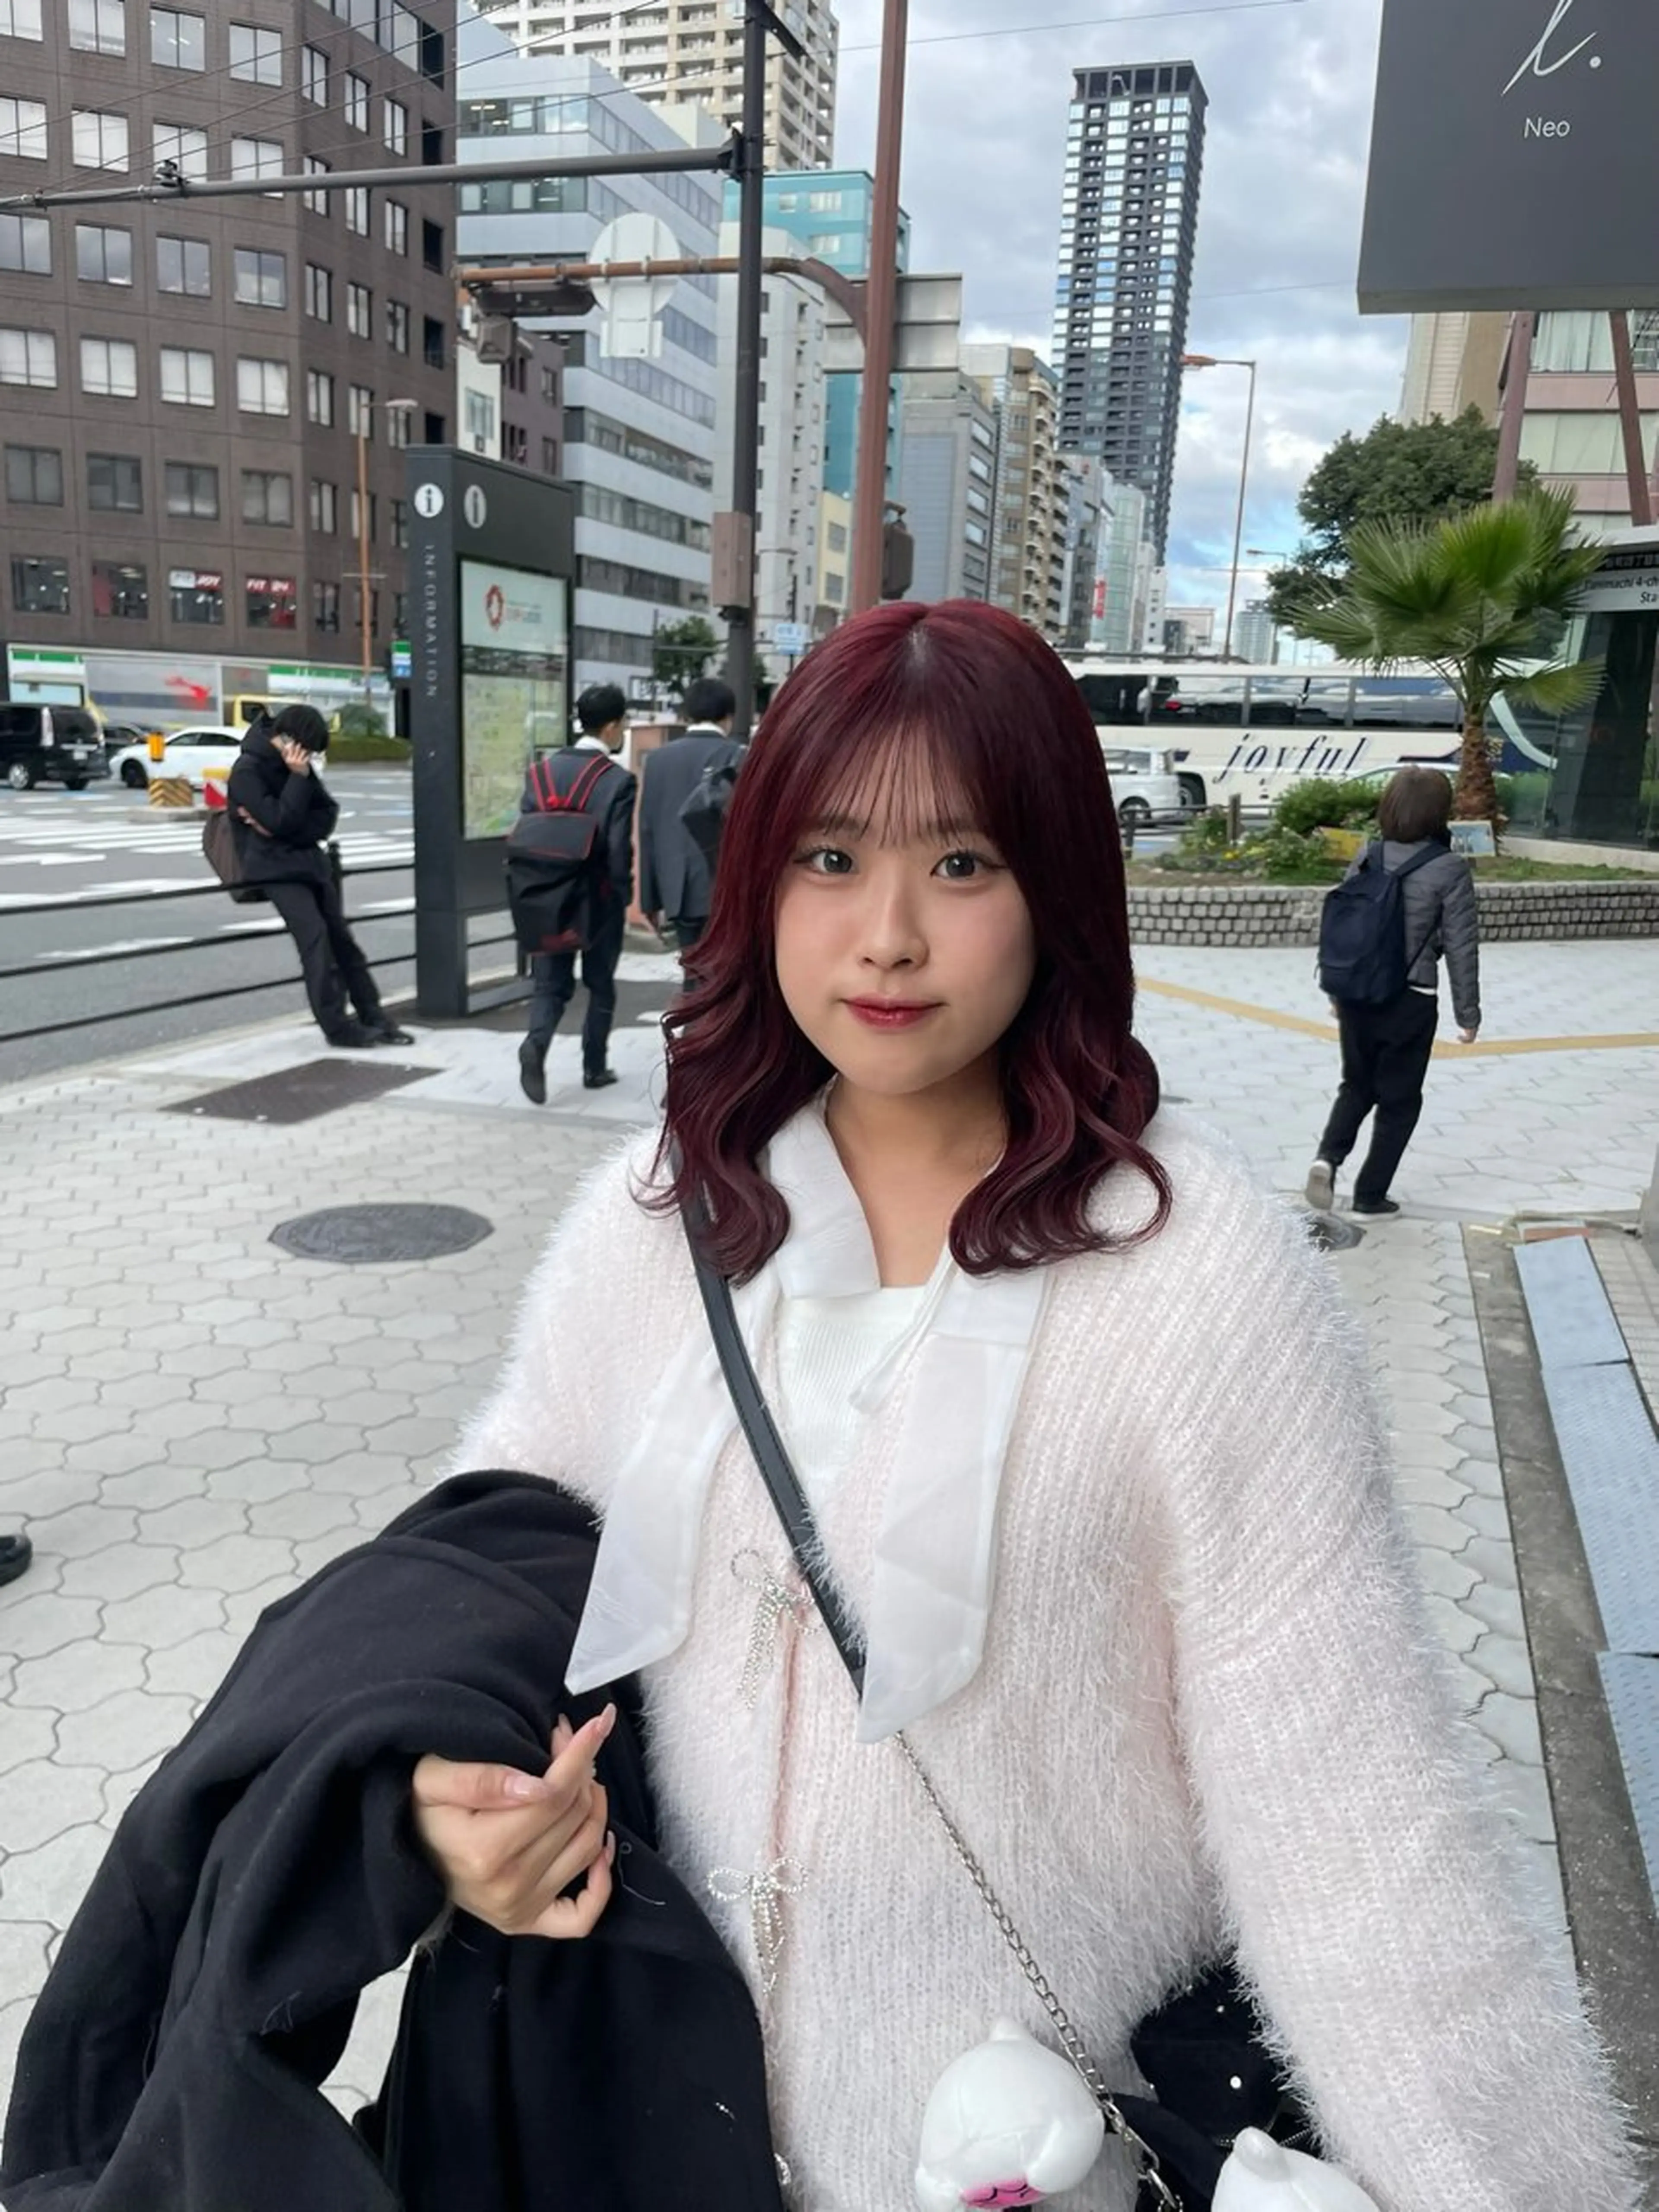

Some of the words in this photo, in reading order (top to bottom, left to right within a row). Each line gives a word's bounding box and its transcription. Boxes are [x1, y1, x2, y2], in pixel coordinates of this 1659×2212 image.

[1524, 117, 1570, 139] Neo
[424, 544, 438, 697] INFORMATION
[1212, 733, 1367, 785] joyful
